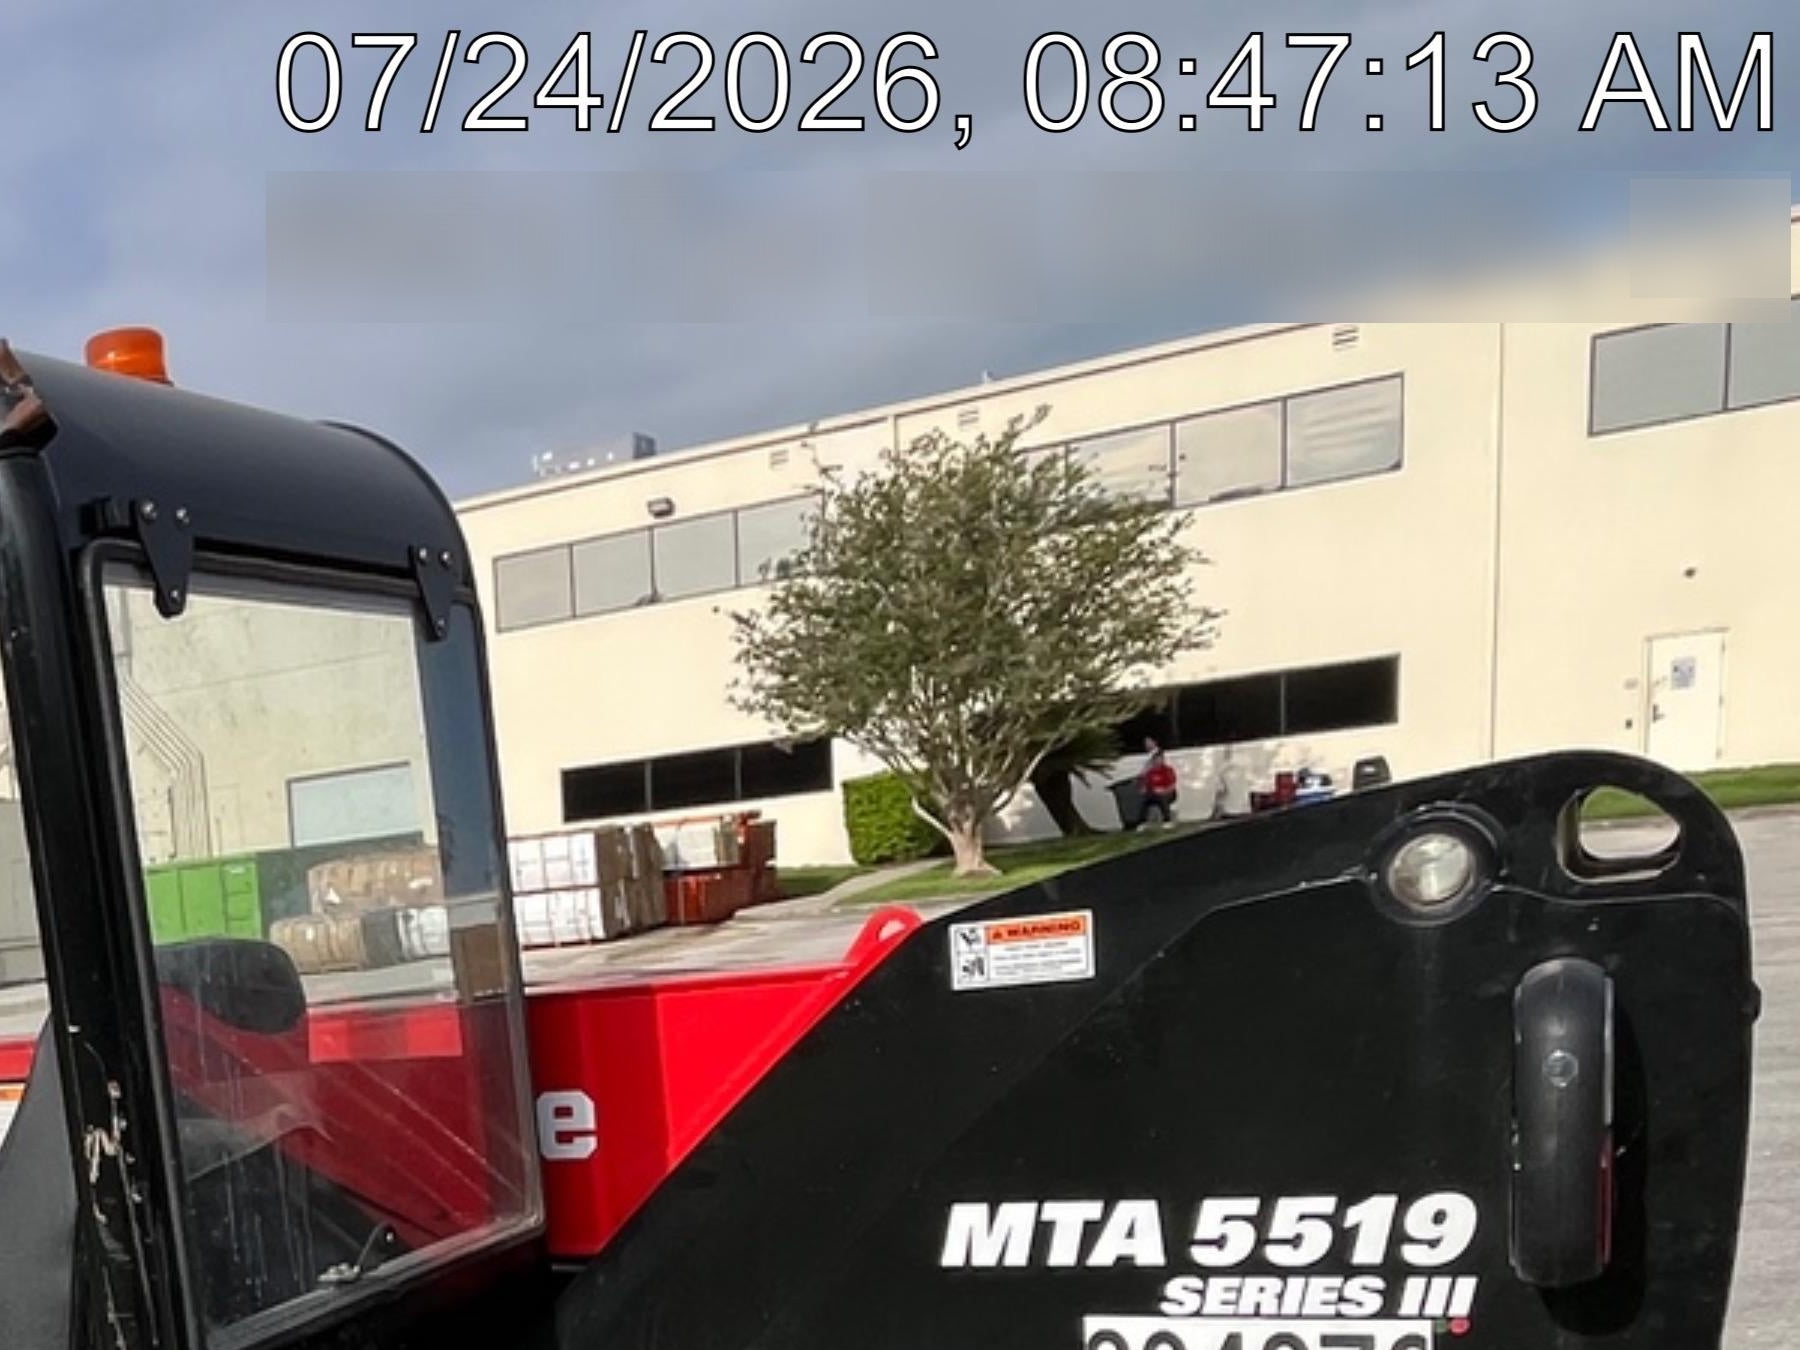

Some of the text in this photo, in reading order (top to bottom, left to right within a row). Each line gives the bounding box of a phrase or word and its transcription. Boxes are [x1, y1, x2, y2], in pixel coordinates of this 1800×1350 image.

[940, 1192, 1478, 1268] MTA 5519
[1159, 1275, 1479, 1318] SERIES III
